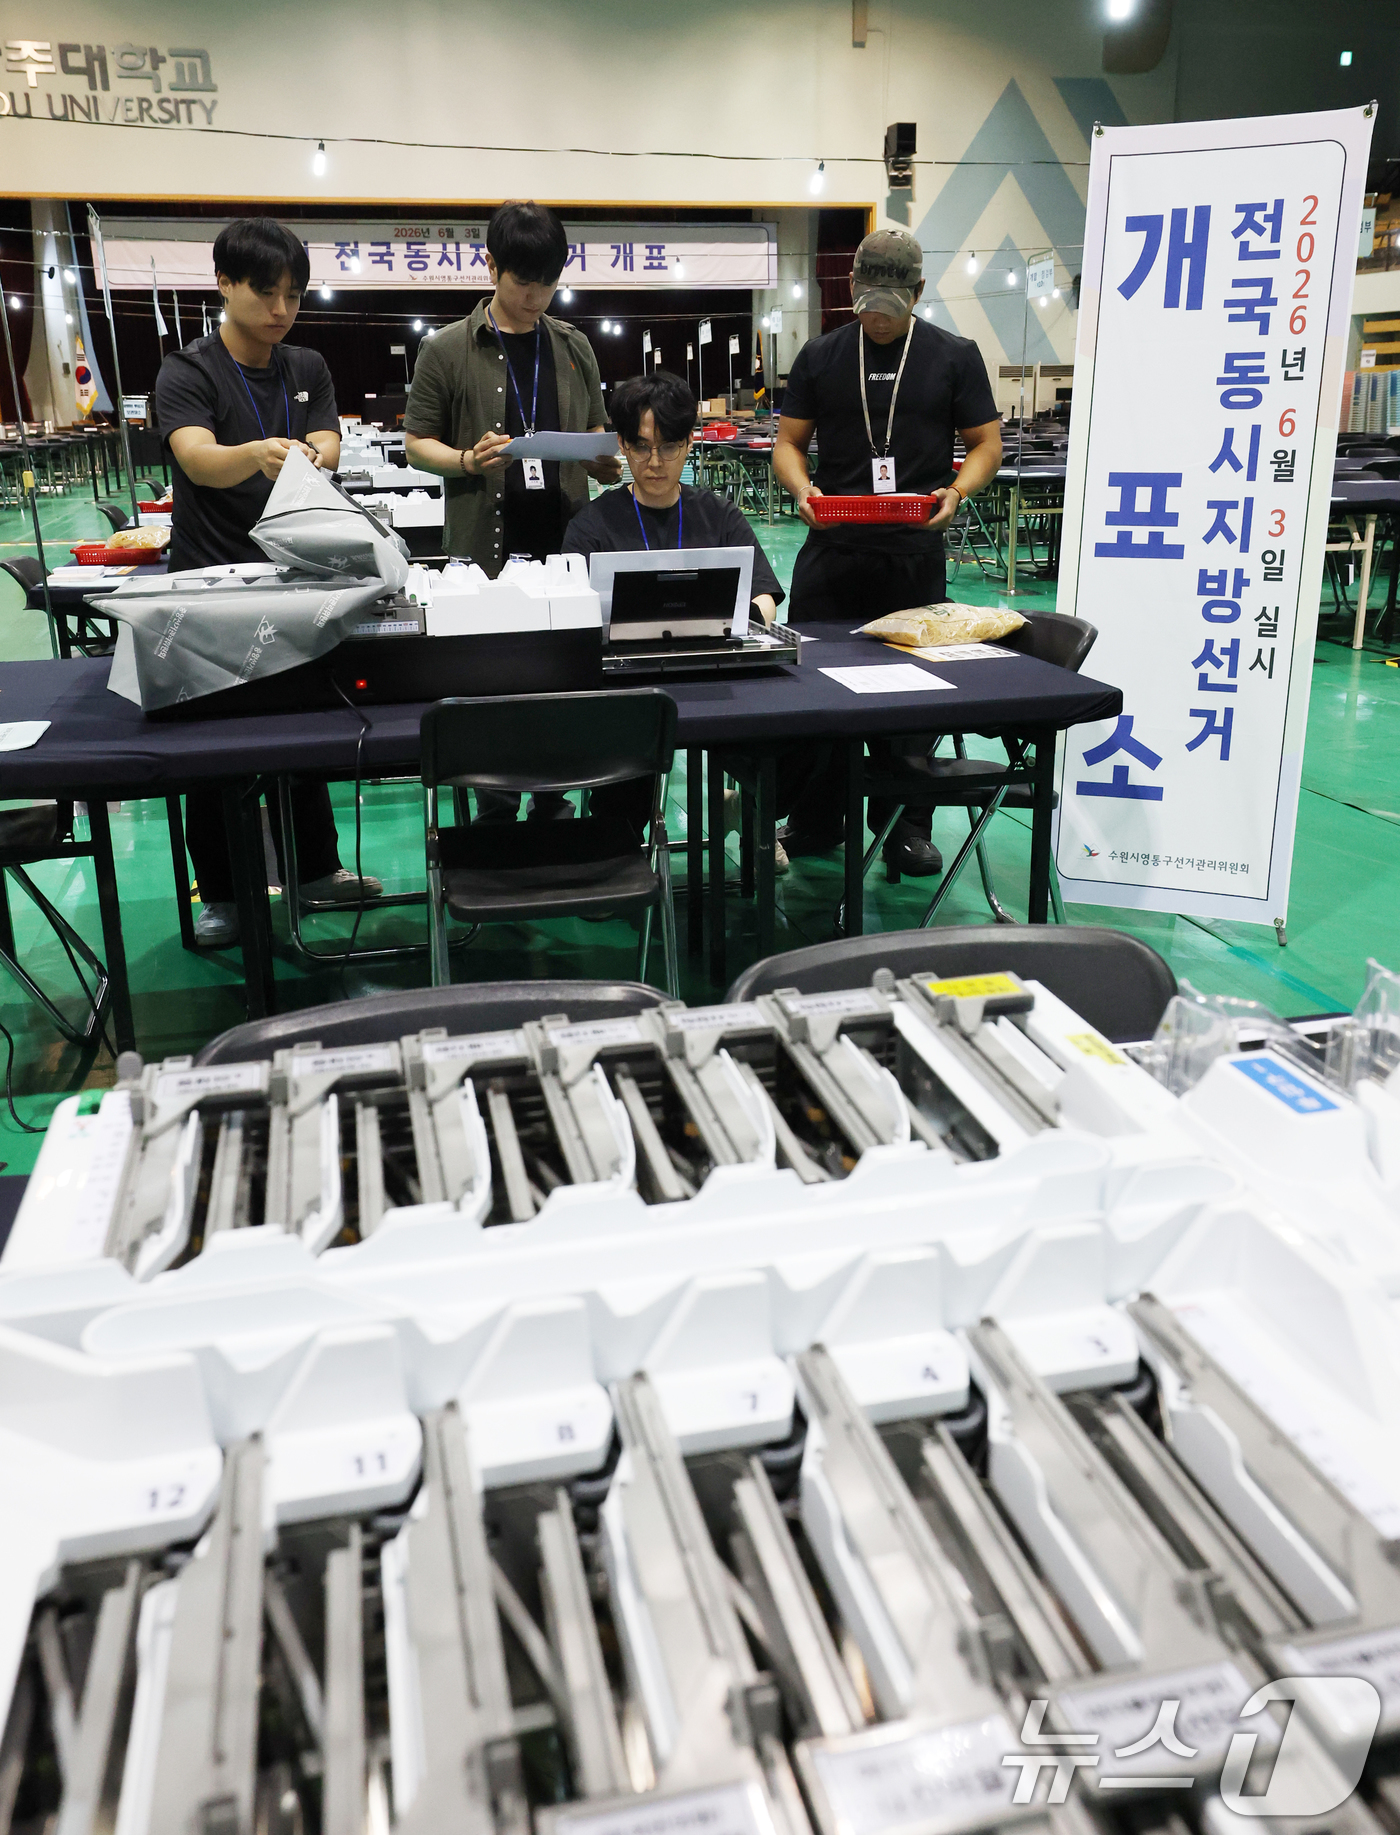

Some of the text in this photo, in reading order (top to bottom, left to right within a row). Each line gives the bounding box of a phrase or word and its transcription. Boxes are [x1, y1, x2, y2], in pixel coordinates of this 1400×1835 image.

[0, 40, 218, 93] 주대학교
[46, 93, 218, 125] UNIVERSITY
[394, 227, 481, 239] 2026년 6월 3일
[610, 242, 668, 272] 개표
[868, 372, 896, 381] FREEDOM
[1248, 195, 1319, 679] 2026년 6월 3일 실시
[1185, 198, 1285, 761] 전국동시지방선거
[1108, 850, 1250, 875] 수원시영통구선거관리위원회
[354, 1452, 387, 1476] 11
[148, 1484, 186, 1510] 12
